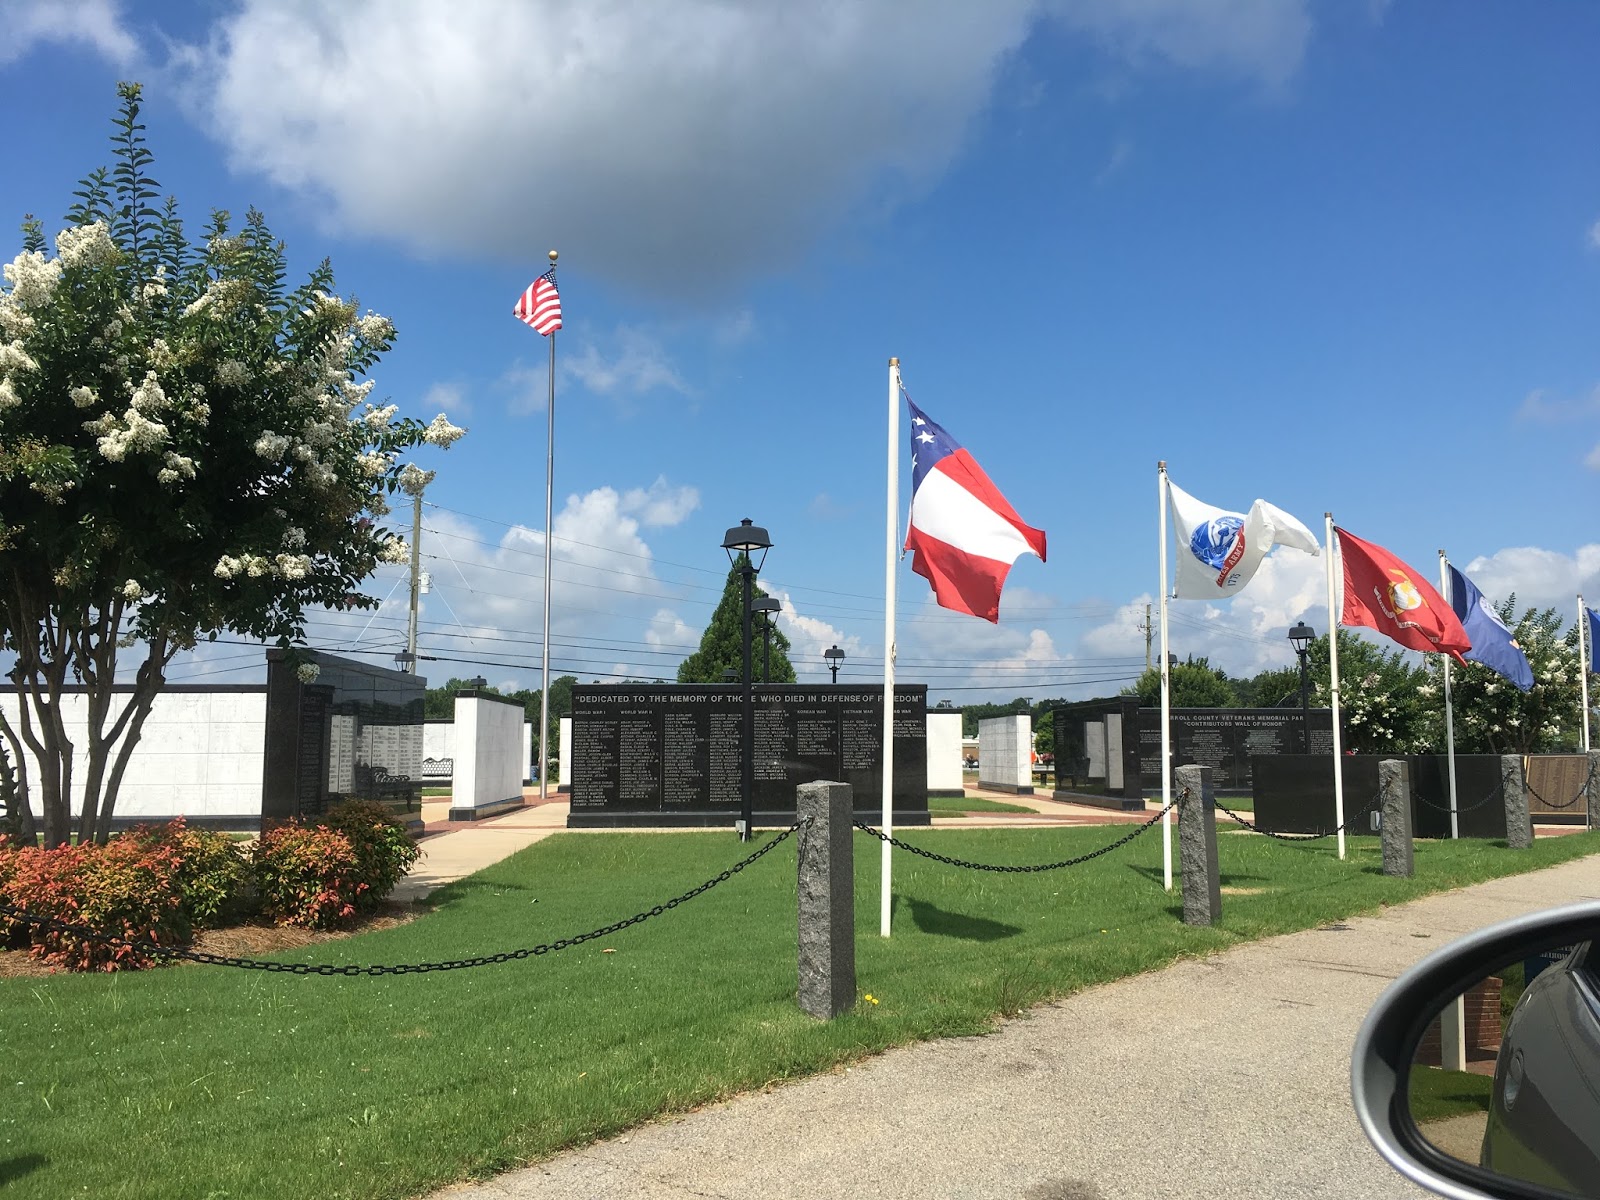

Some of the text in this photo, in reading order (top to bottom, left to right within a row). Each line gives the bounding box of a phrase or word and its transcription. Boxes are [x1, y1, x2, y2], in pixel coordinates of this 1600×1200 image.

[1228, 541, 1244, 566] ARMY
[1227, 572, 1242, 587] 1775
[632, 695, 646, 703] TO
[649, 695, 668, 703] THE
[670, 695, 708, 703] MEMORY
[710, 695, 723, 703] OF
[726, 695, 757, 703] THOE
[760, 695, 782, 703] WHO
[784, 695, 805, 703] DIED
[808, 695, 817, 703] IN
[821, 694, 861, 703] DEFENSE
[862, 694, 875, 703] OF
[877, 695, 923, 703] FEDOM"
